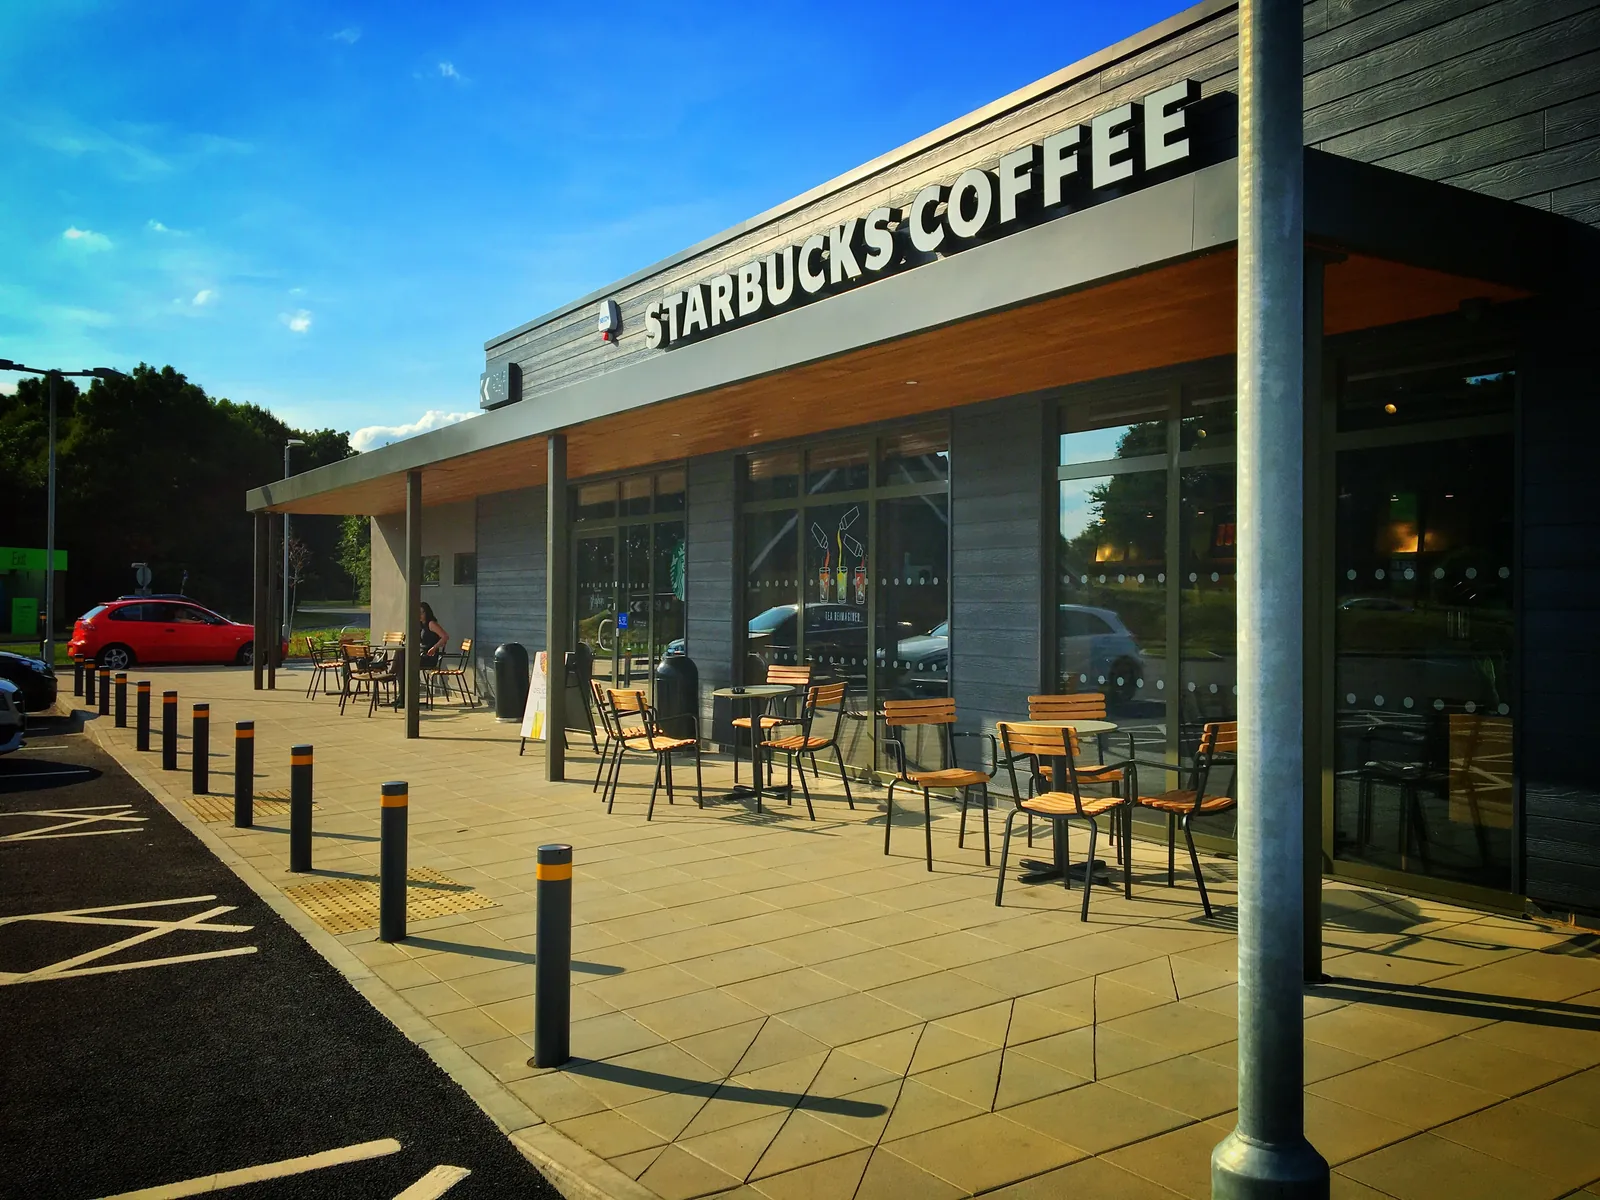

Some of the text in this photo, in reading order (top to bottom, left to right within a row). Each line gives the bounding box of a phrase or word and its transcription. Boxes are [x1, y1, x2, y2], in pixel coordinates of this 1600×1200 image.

[644, 78, 1190, 350] STARBUCKS COFFEE
[12, 551, 27, 566] Exit
